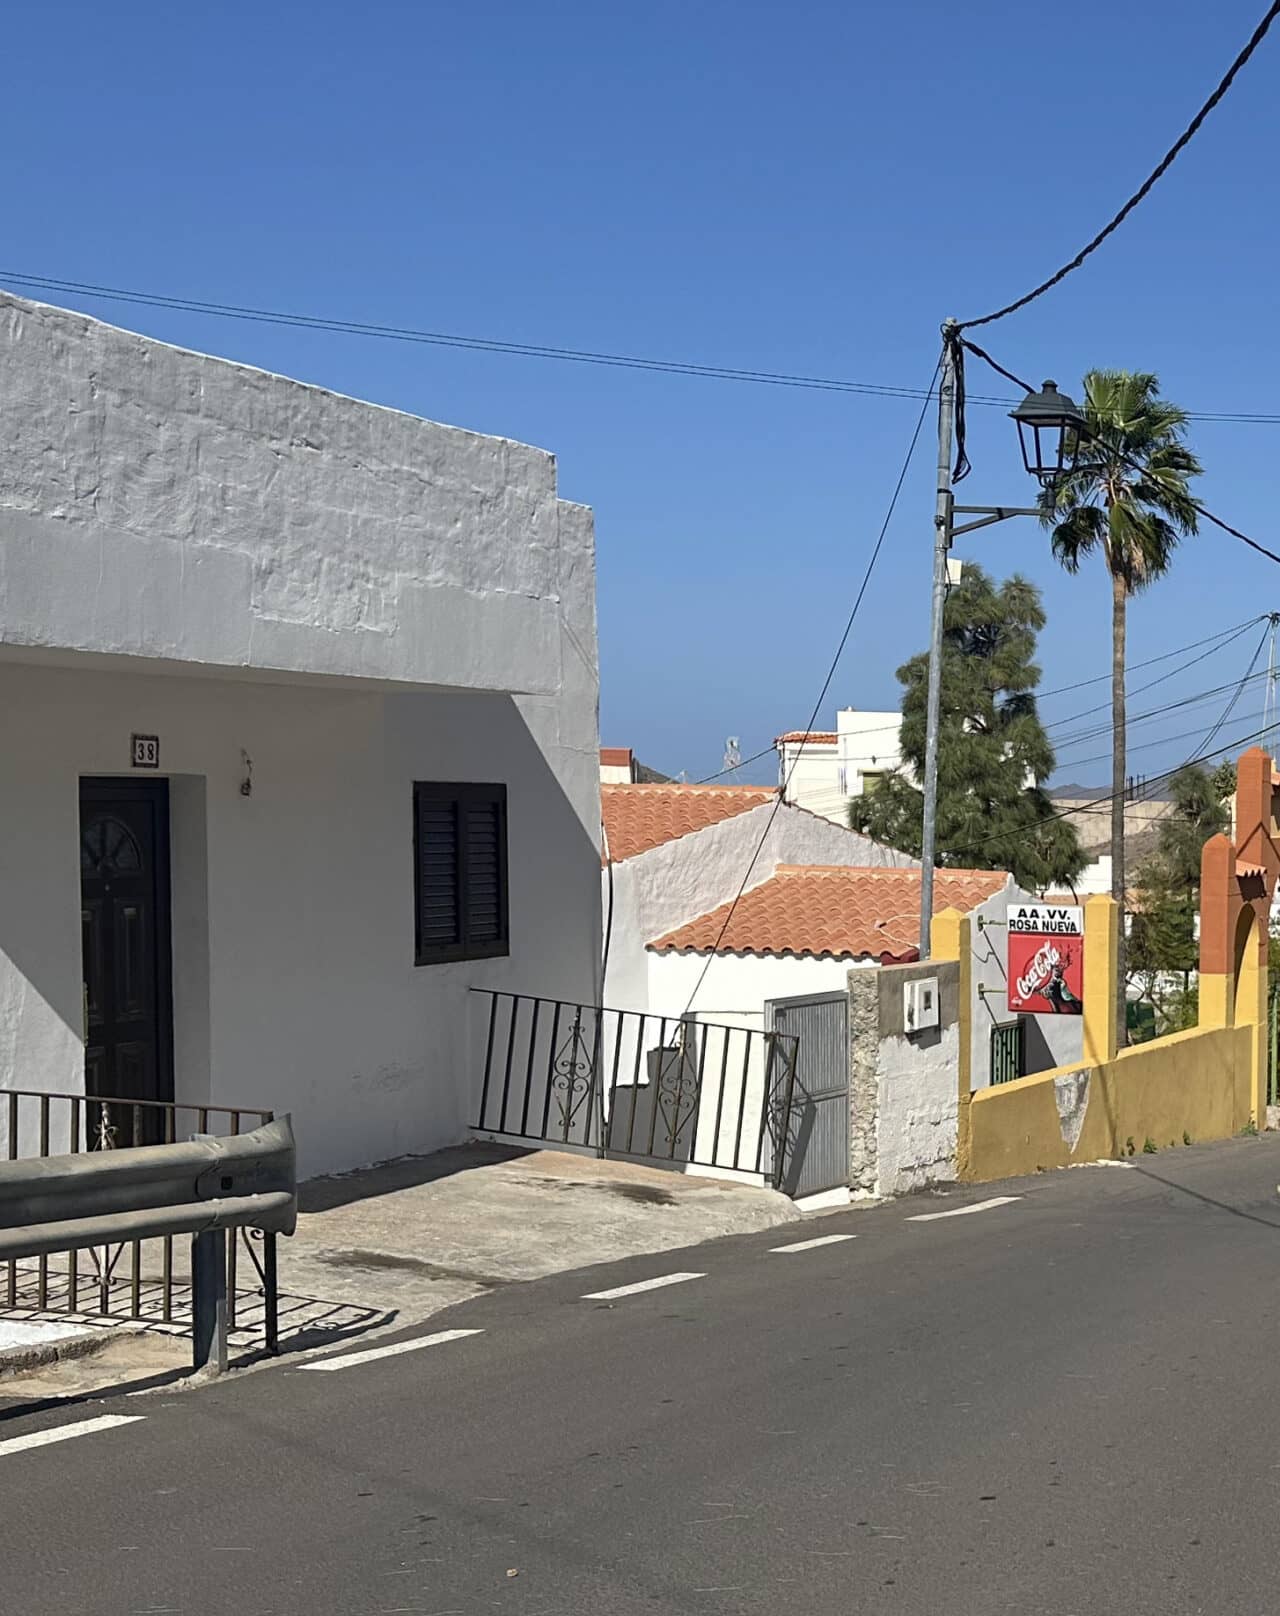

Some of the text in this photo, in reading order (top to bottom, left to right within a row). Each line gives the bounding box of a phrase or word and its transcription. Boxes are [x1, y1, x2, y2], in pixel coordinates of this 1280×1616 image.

[138, 743, 154, 761] 38
[1017, 908, 1071, 920] AA.VV.
[1009, 919, 1077, 932] ROSA NUEVA
